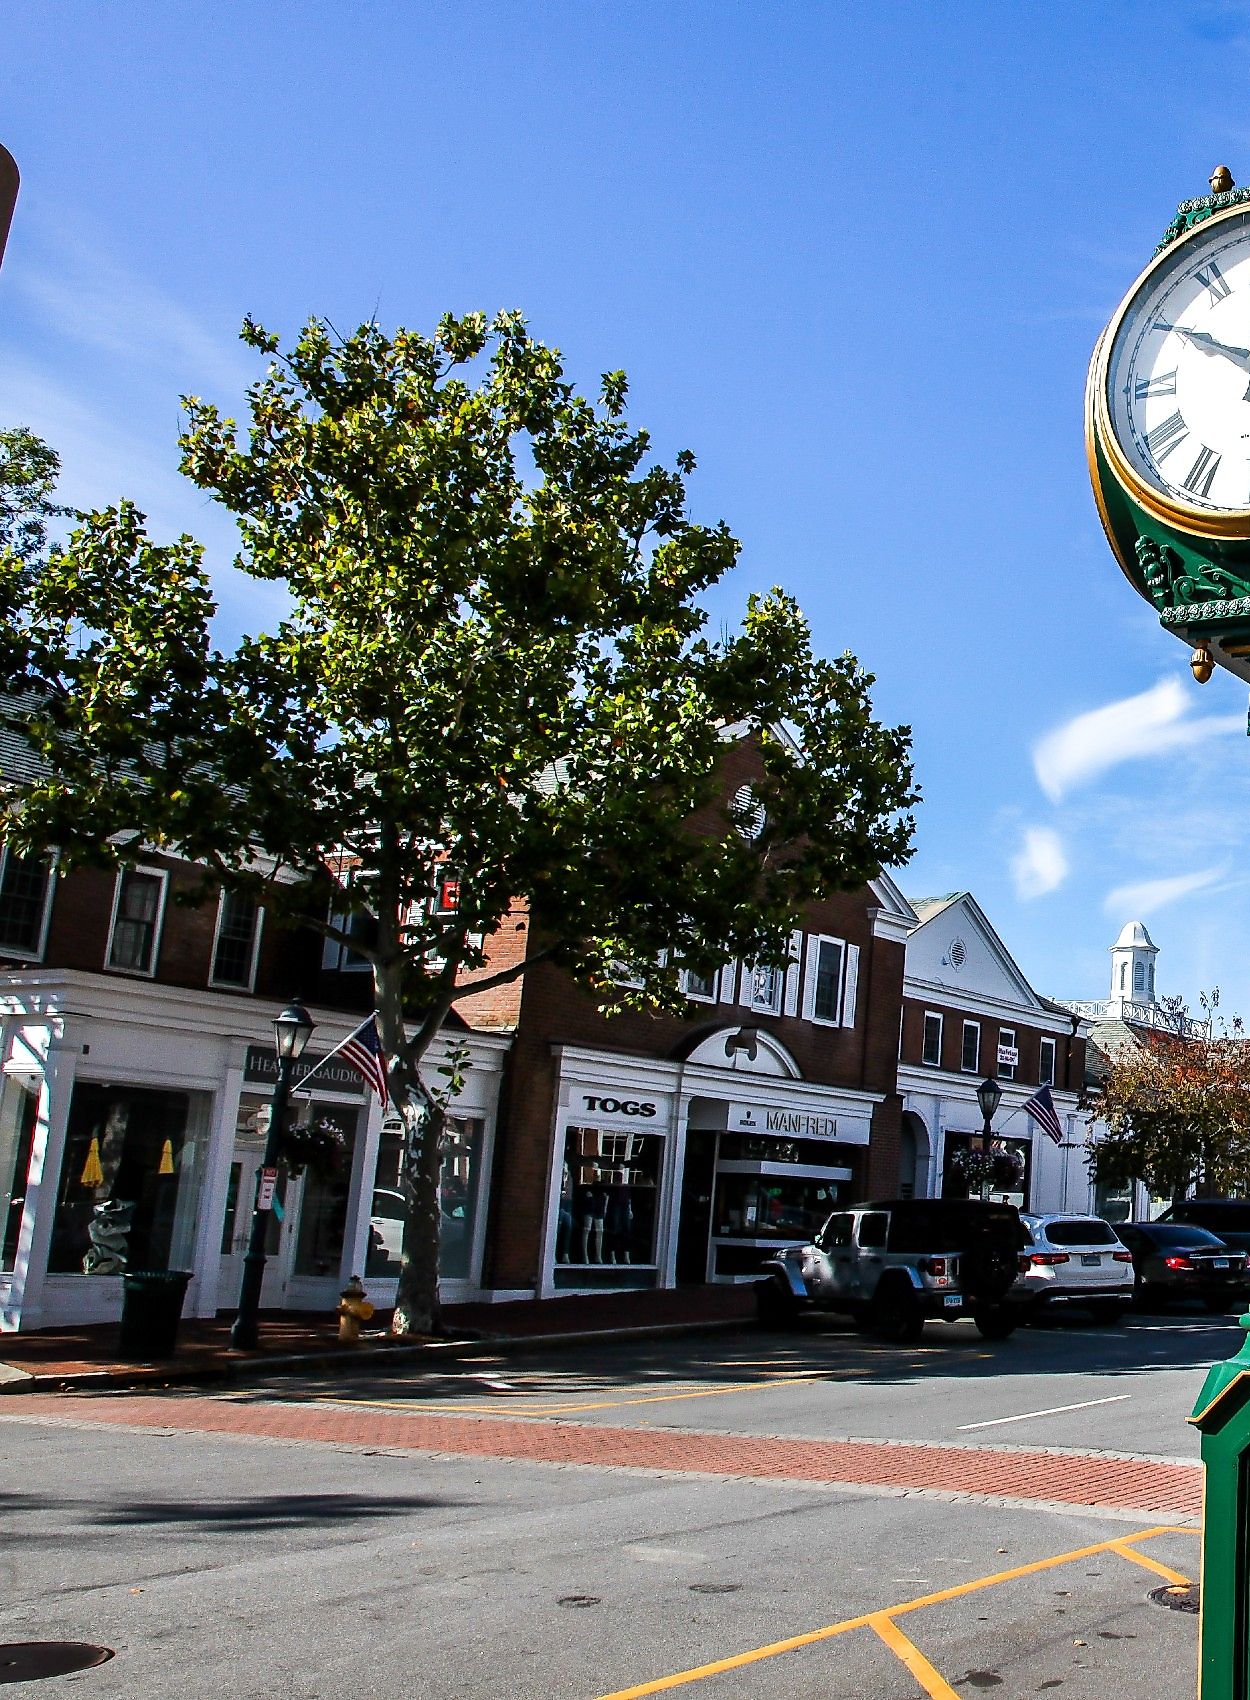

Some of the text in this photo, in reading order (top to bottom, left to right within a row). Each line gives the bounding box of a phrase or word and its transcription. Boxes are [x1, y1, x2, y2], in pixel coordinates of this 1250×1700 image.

[1190, 258, 1236, 310] XI
[1140, 407, 1191, 470] VIII
[1178, 442, 1223, 500] VII
[582, 1095, 657, 1118] TOGS
[765, 1110, 837, 1137] MANFREDI
